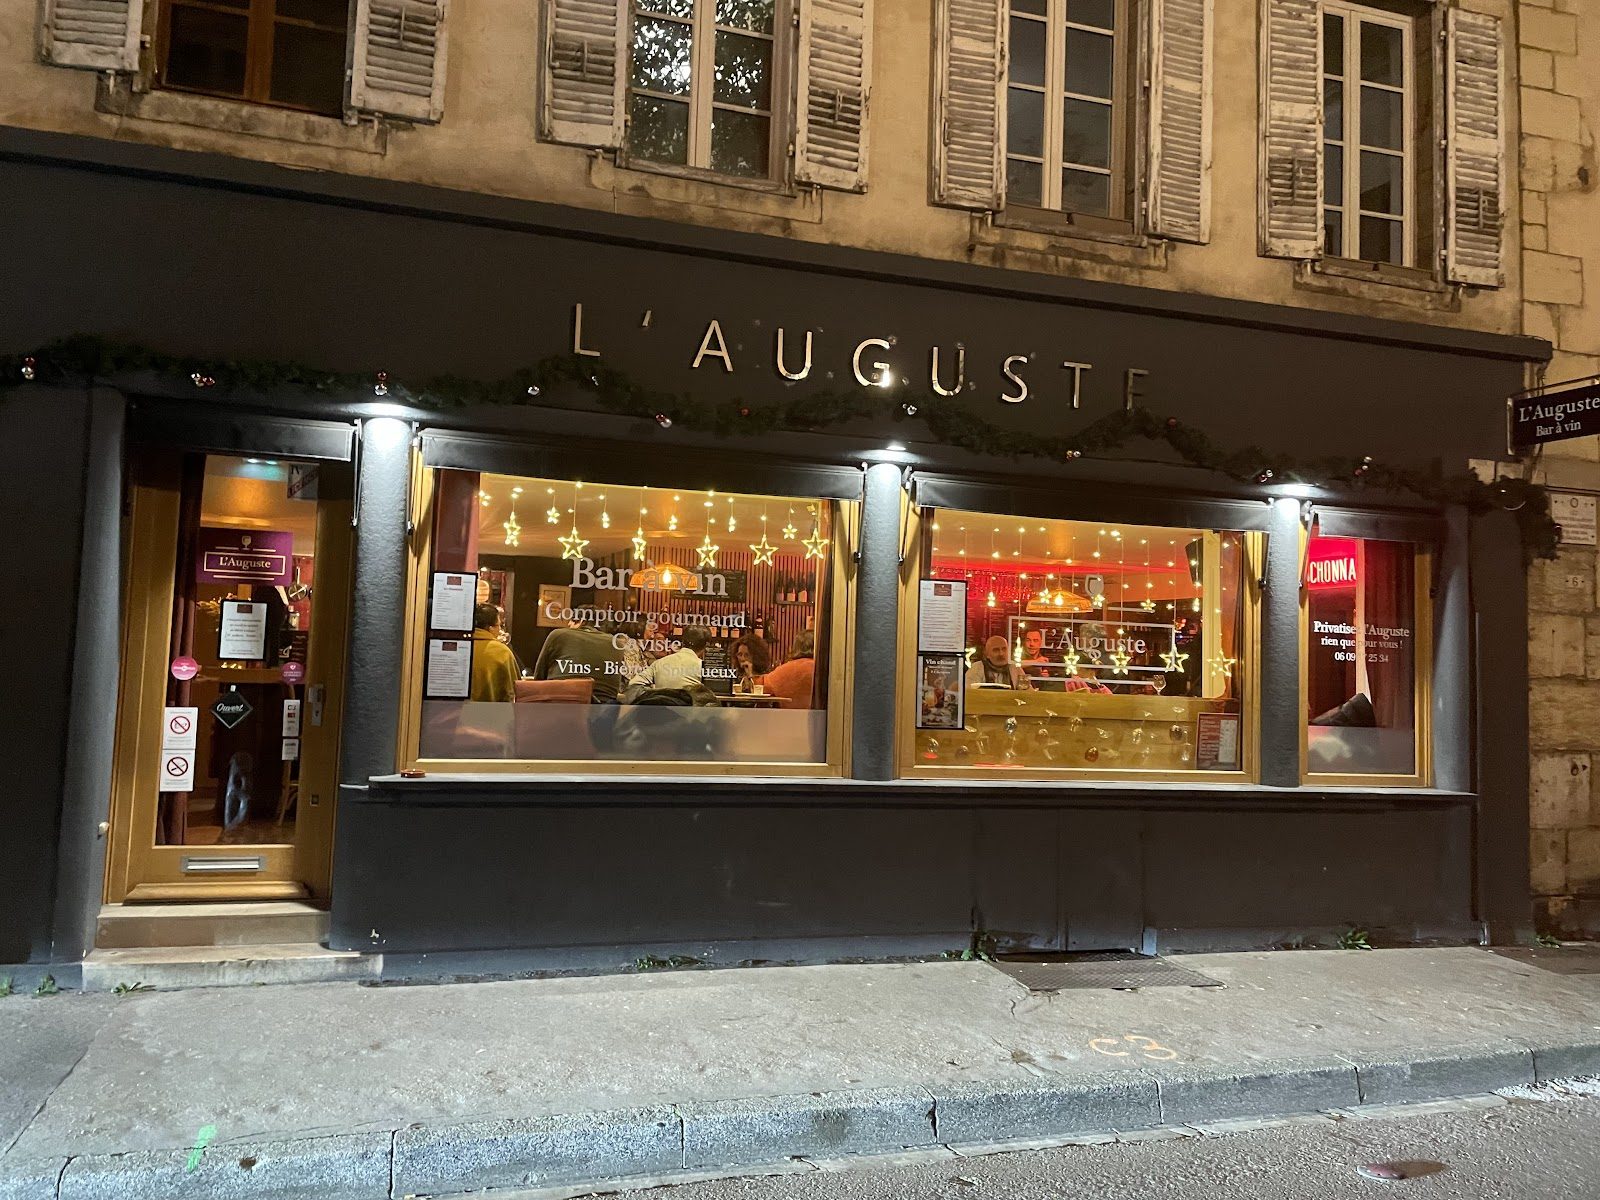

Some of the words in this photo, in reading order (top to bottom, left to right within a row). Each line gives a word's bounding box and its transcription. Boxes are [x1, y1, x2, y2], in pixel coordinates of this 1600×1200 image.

[1519, 397, 1600, 422] L'Auguste
[1536, 425, 1554, 437] Bar
[1555, 422, 1562, 434] à
[1564, 420, 1581, 432] vin
[219, 556, 271, 570] L'Auguste
[1307, 557, 1356, 584] CHONNA
[568, 556, 633, 591] Bar
[643, 559, 662, 593] à
[673, 565, 729, 596] vin
[545, 601, 642, 628] Comptoir
[646, 610, 746, 632] gourmand
[1313, 620, 1361, 634] Privatise
[612, 632, 682, 653] Caviste
[1039, 628, 1147, 660] L'Auguste
[1320, 635, 1339, 646] rien
[1339, 638, 1356, 649] que
[1358, 640, 1377, 651] our
[1378, 641, 1399, 649] vous
[1334, 651, 1345, 661] 06
[1345, 652, 1356, 662] 09
[556, 659, 592, 674] Vins
